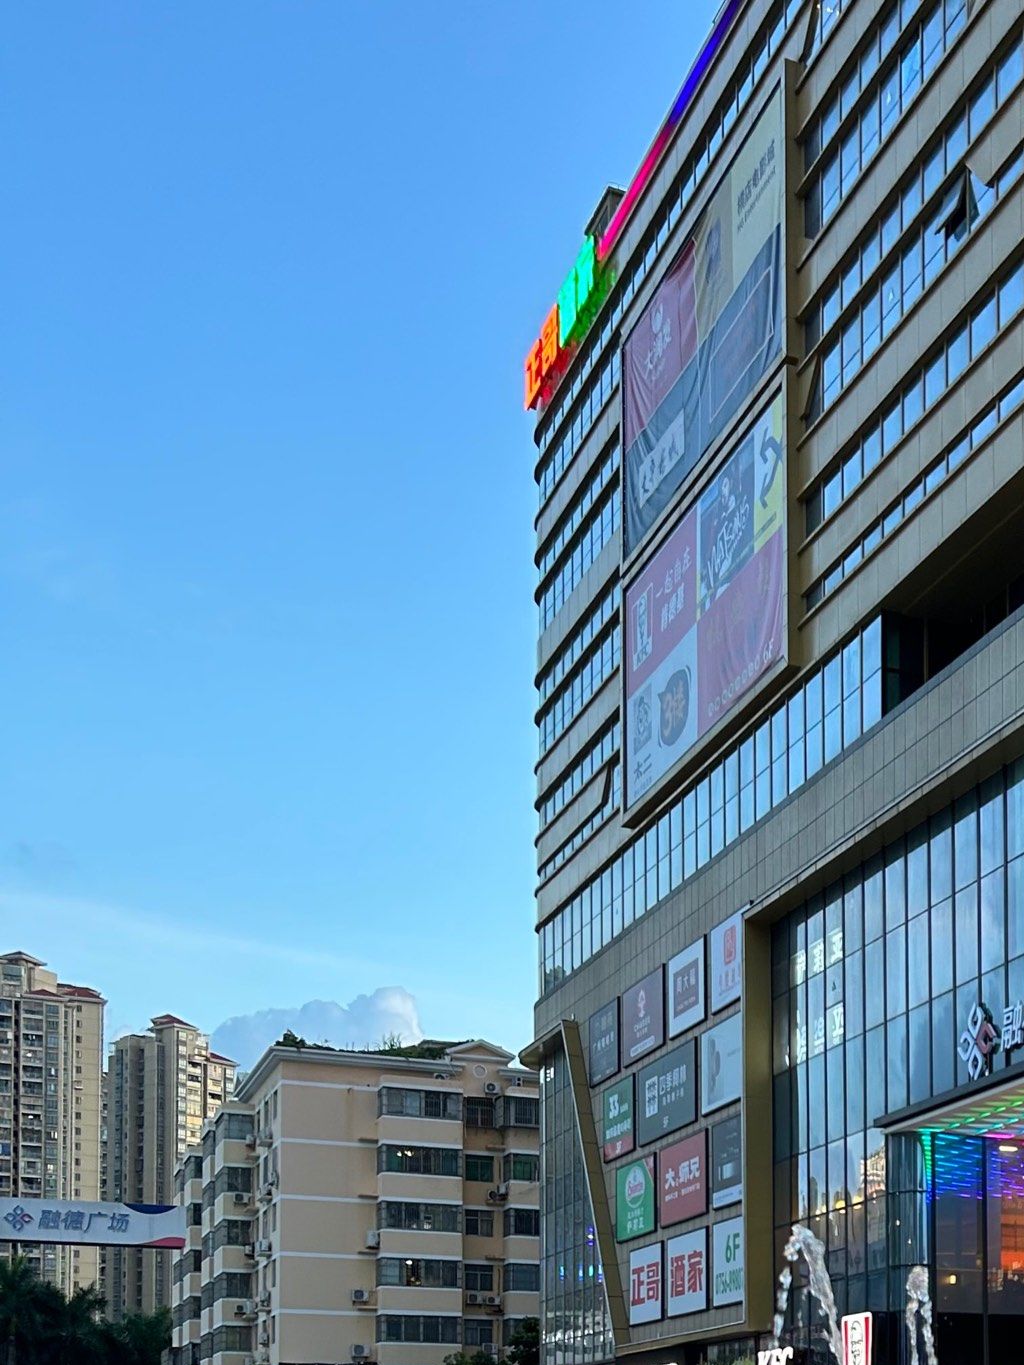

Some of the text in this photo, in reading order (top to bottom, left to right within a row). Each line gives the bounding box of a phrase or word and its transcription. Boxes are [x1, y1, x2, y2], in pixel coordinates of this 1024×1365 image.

[524, 234, 595, 411] 正哥
[38, 1208, 131, 1234] 融德广场
[725, 1232, 740, 1264] 6F
[631, 1250, 704, 1307] 正哥 酒家
